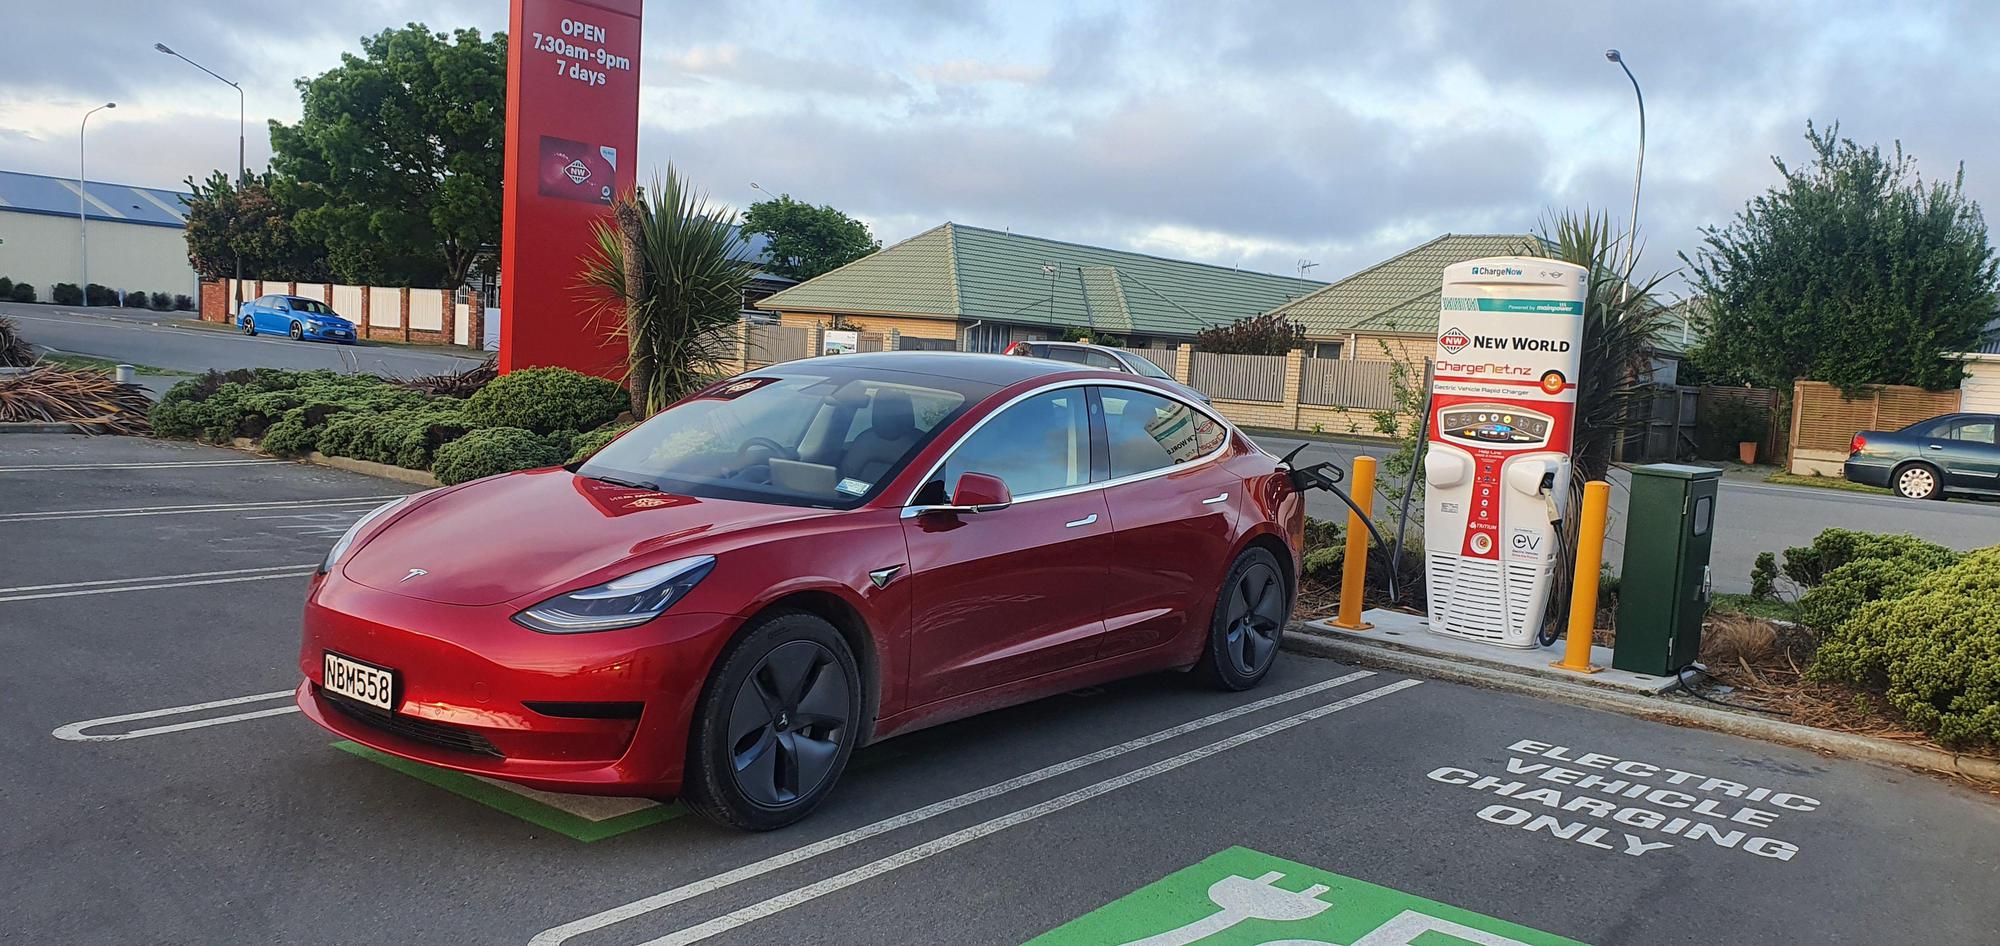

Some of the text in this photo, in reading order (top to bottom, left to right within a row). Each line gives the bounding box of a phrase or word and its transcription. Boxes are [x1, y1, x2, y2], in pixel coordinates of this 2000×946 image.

[561, 18, 606, 44] OPEN
[532, 32, 630, 71] 7.30am-9pm
[556, 59, 606, 86] 7 days
[570, 167, 586, 177] NW
[1479, 267, 1523, 277] ChargeNow
[1445, 335, 1570, 353] NW NEW WORLD
[1436, 360, 1532, 376] ChargeNet.nz
[326, 658, 389, 704] NBM558
[1505, 739, 1822, 812] ELECTRIC
[1506, 757, 1780, 829] VEHICLE
[1426, 766, 1800, 862] CHARGING
[1475, 804, 1675, 857] ONLY
